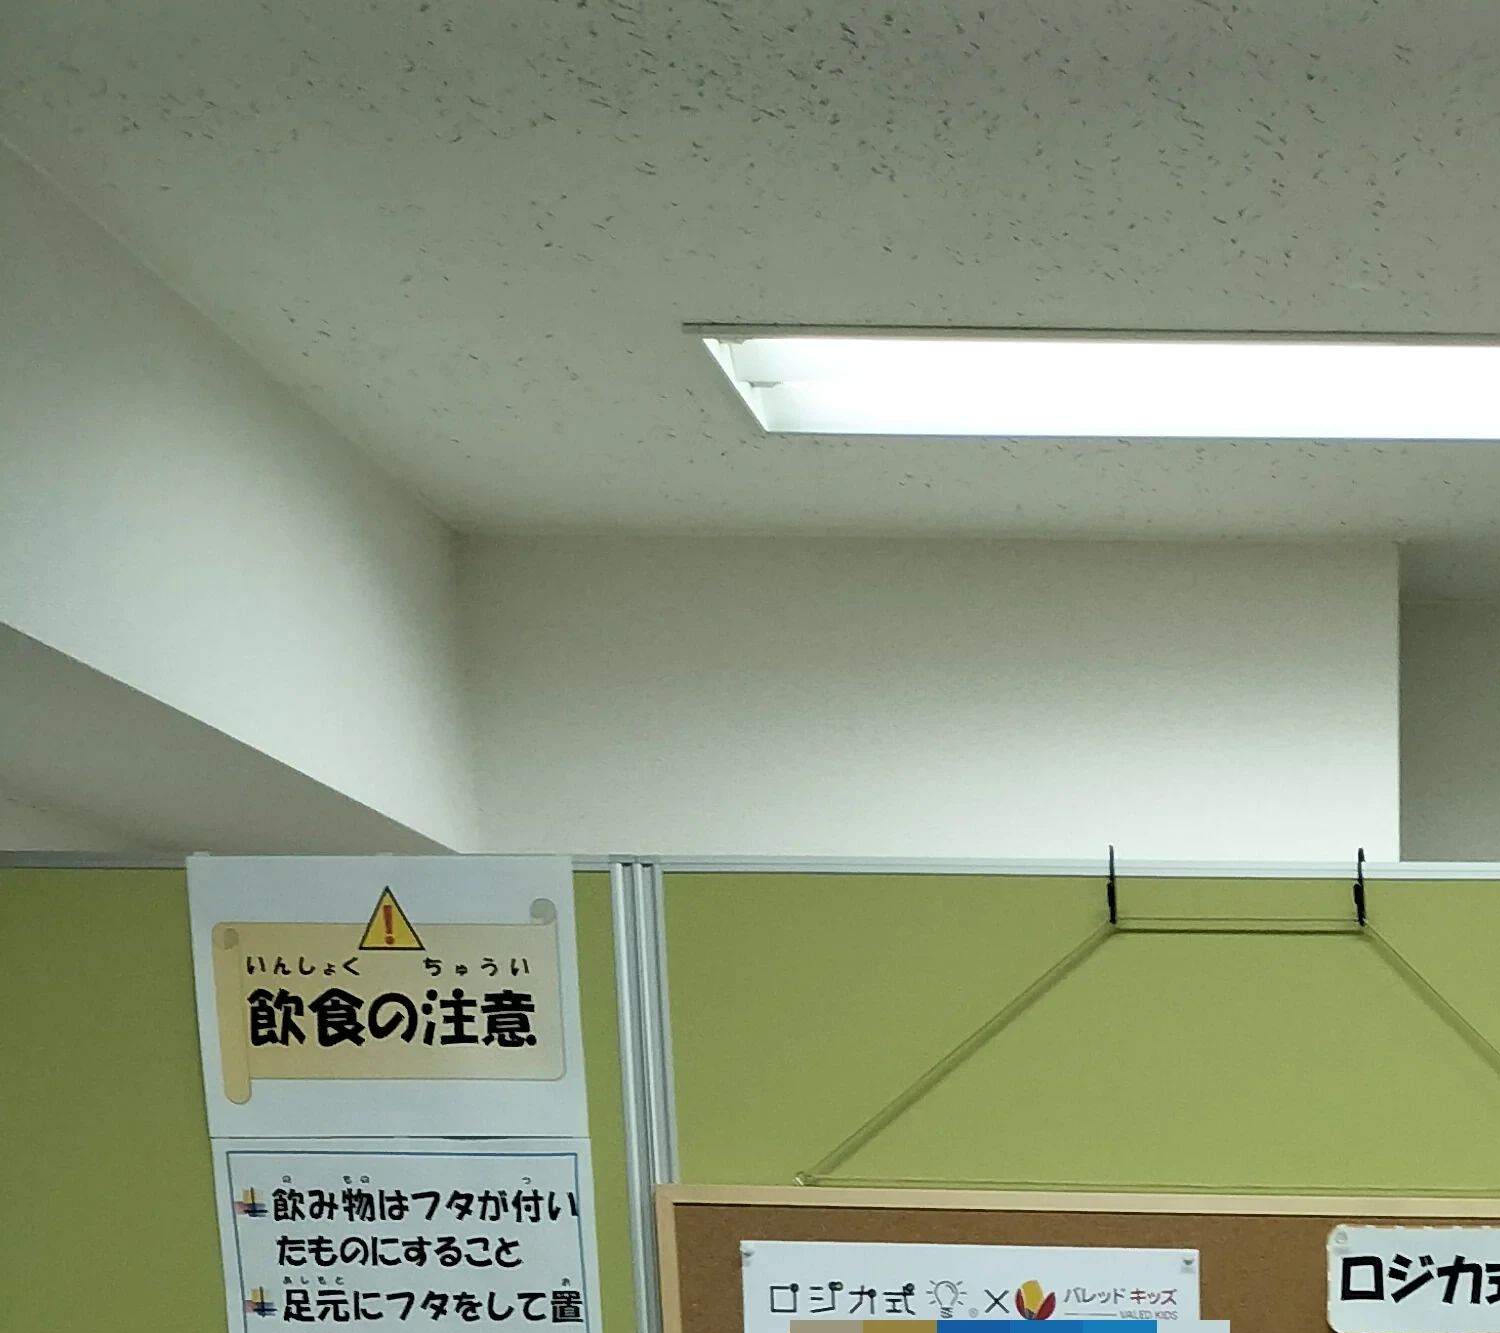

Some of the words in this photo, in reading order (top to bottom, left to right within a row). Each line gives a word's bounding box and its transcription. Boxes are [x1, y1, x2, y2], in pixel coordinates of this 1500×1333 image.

[247, 957, 360, 976] いんしょく
[423, 957, 530, 977] ちゅうい
[247, 988, 537, 1047] 飲食の注意
[273, 1188, 579, 1223] 飲み物はフタが付い
[276, 1235, 524, 1268] たものにすること
[284, 1289, 584, 1323] 足元にフタをして置
[769, 1281, 916, 1316] ロジカ式
